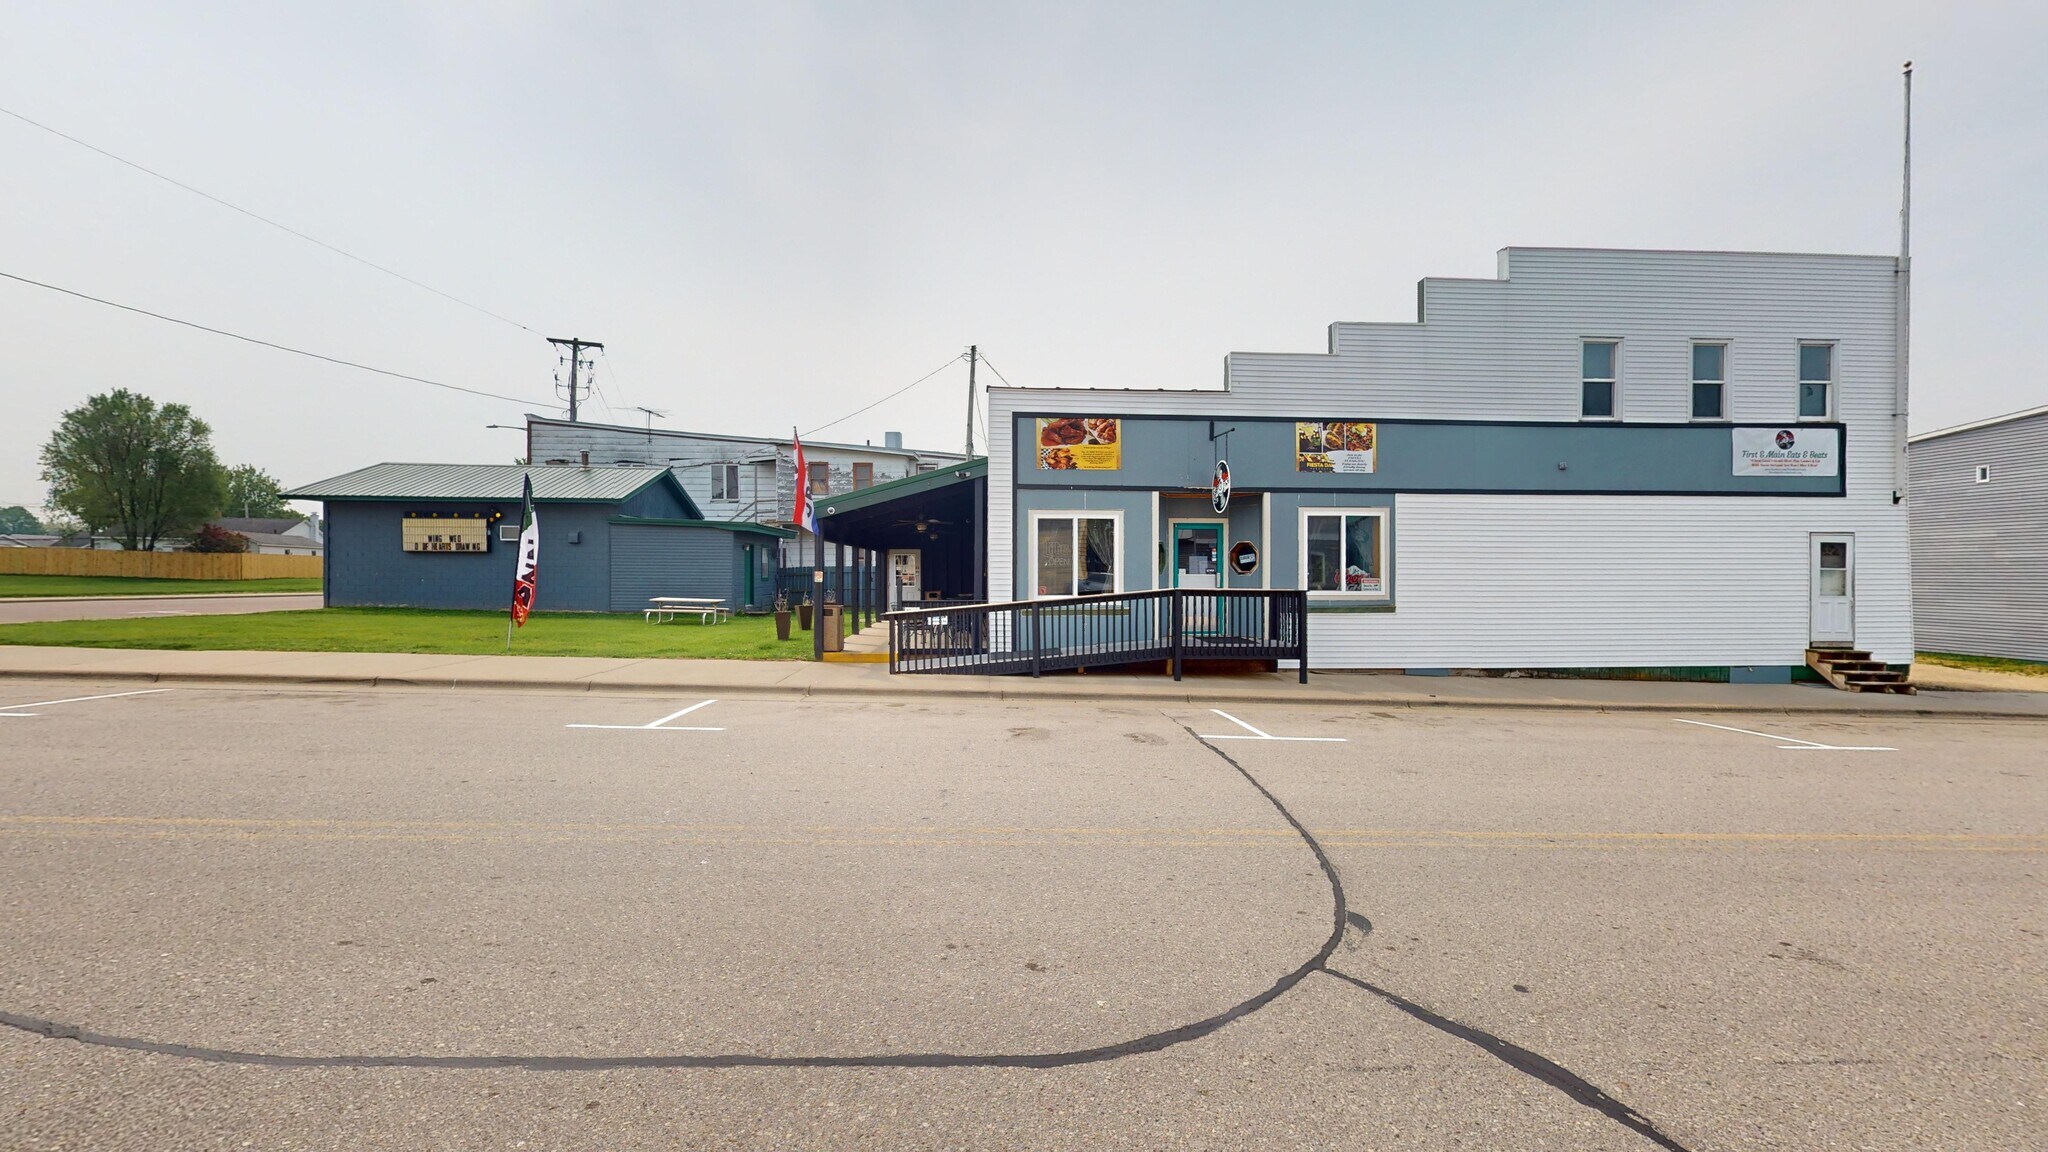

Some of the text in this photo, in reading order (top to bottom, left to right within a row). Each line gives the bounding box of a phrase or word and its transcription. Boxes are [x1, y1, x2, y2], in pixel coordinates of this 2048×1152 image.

[1742, 450, 1758, 458] First
[1766, 450, 1786, 458] Main
[1786, 450, 1801, 458] Eats
[1809, 450, 1828, 458] Beats
[1048, 558, 1070, 566] OPEN
[1334, 569, 1370, 584] Coor
